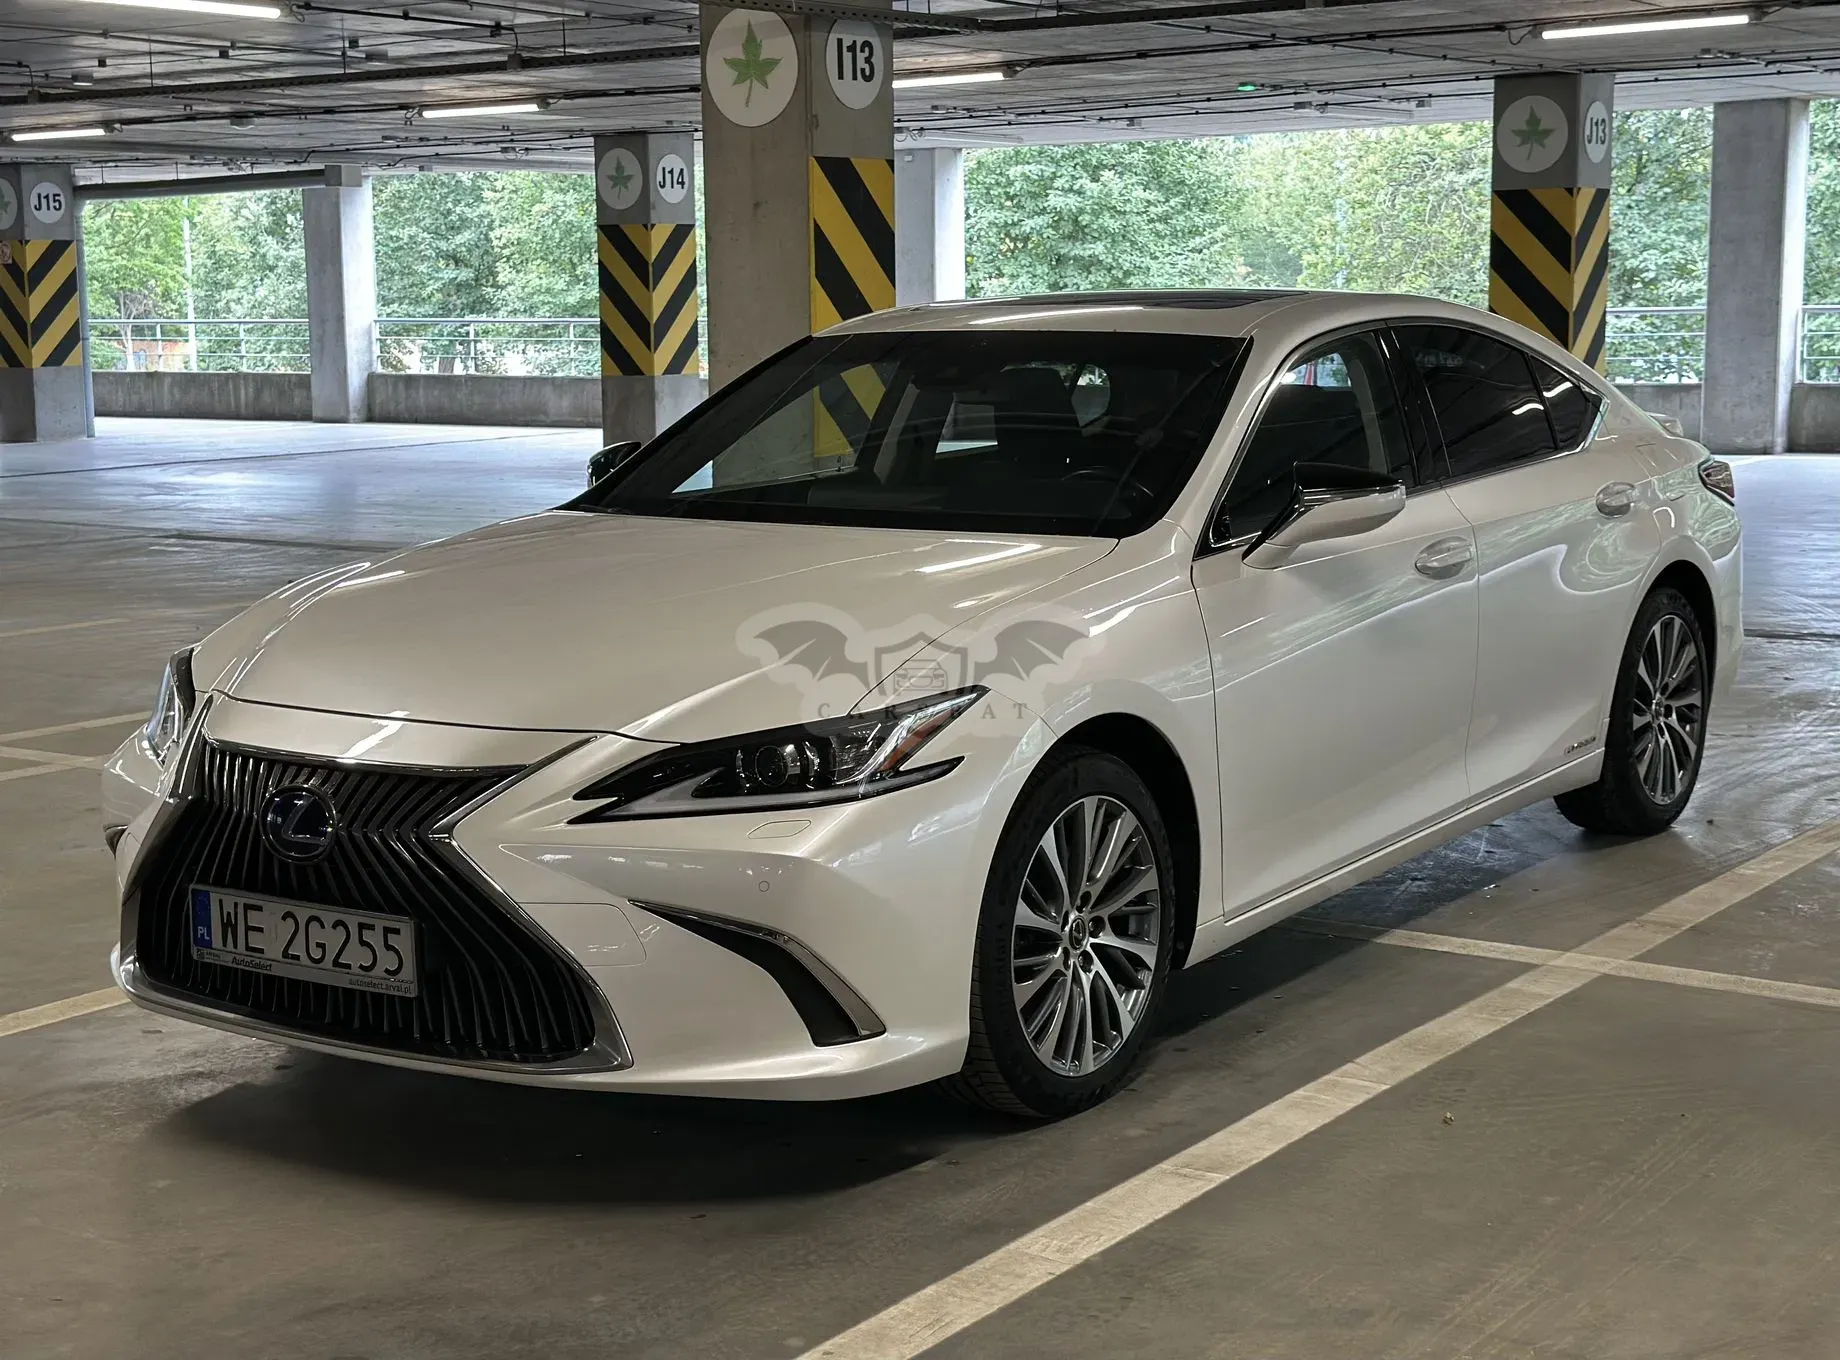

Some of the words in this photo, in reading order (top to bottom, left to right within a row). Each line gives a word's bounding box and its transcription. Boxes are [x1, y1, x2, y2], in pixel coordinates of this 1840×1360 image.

[1586, 116, 1607, 145] J13
[658, 166, 686, 190] J14
[33, 192, 63, 212] J15
[197, 926, 211, 940] PL
[218, 897, 265, 955] WE
[280, 910, 405, 977] 2G255
